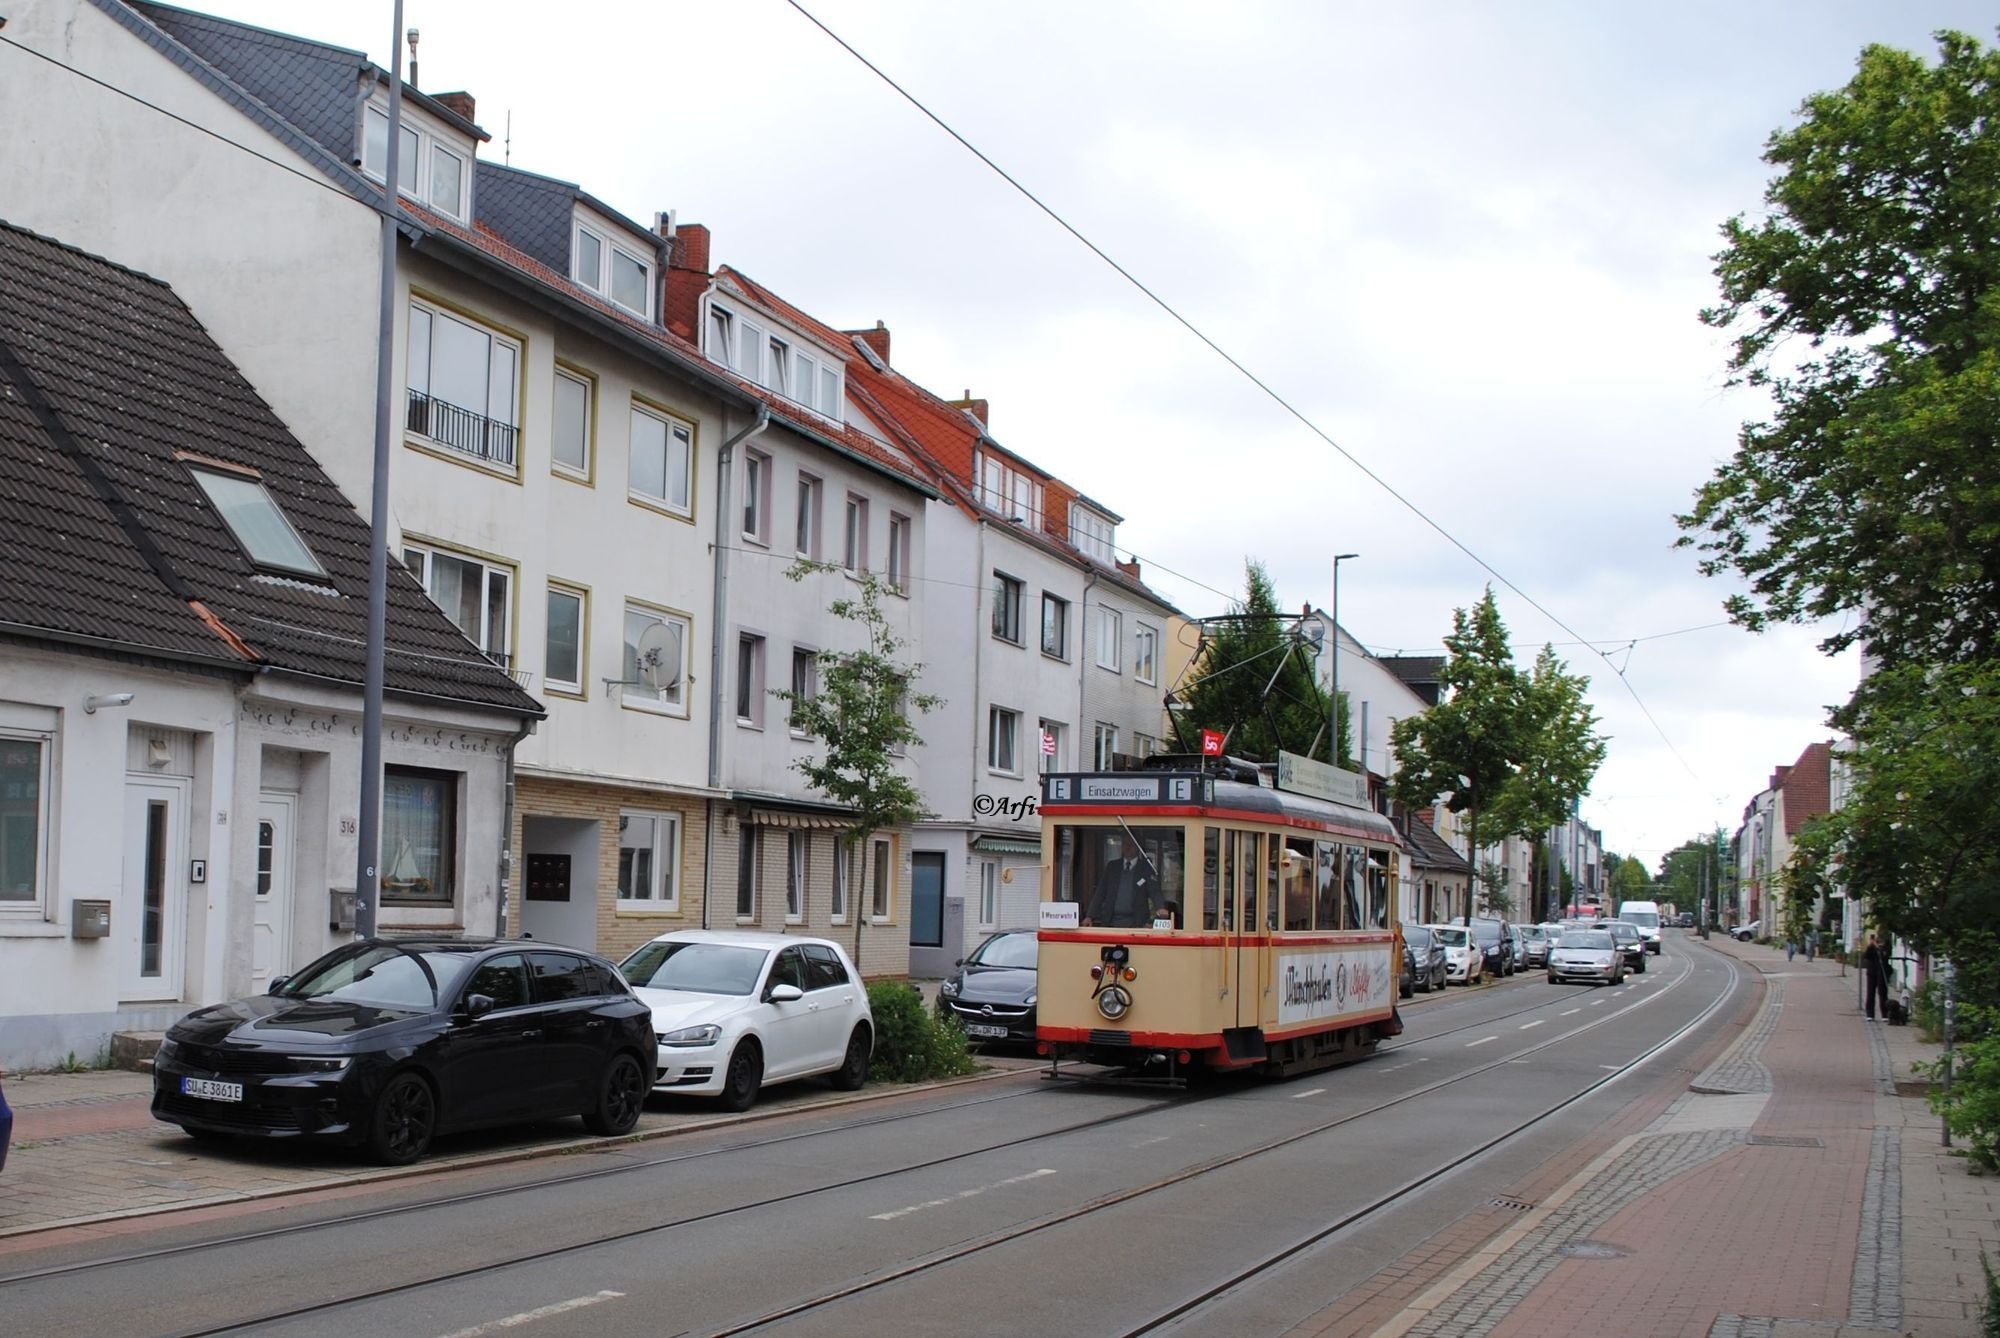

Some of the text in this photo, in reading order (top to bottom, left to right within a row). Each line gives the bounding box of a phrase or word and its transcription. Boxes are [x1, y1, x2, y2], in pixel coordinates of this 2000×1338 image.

[1055, 780, 1185, 799] E Einsatzwagen E
[340, 820, 355, 834] 316
[186, 1079, 198, 1093] SU
[202, 1081, 208, 1095] E
